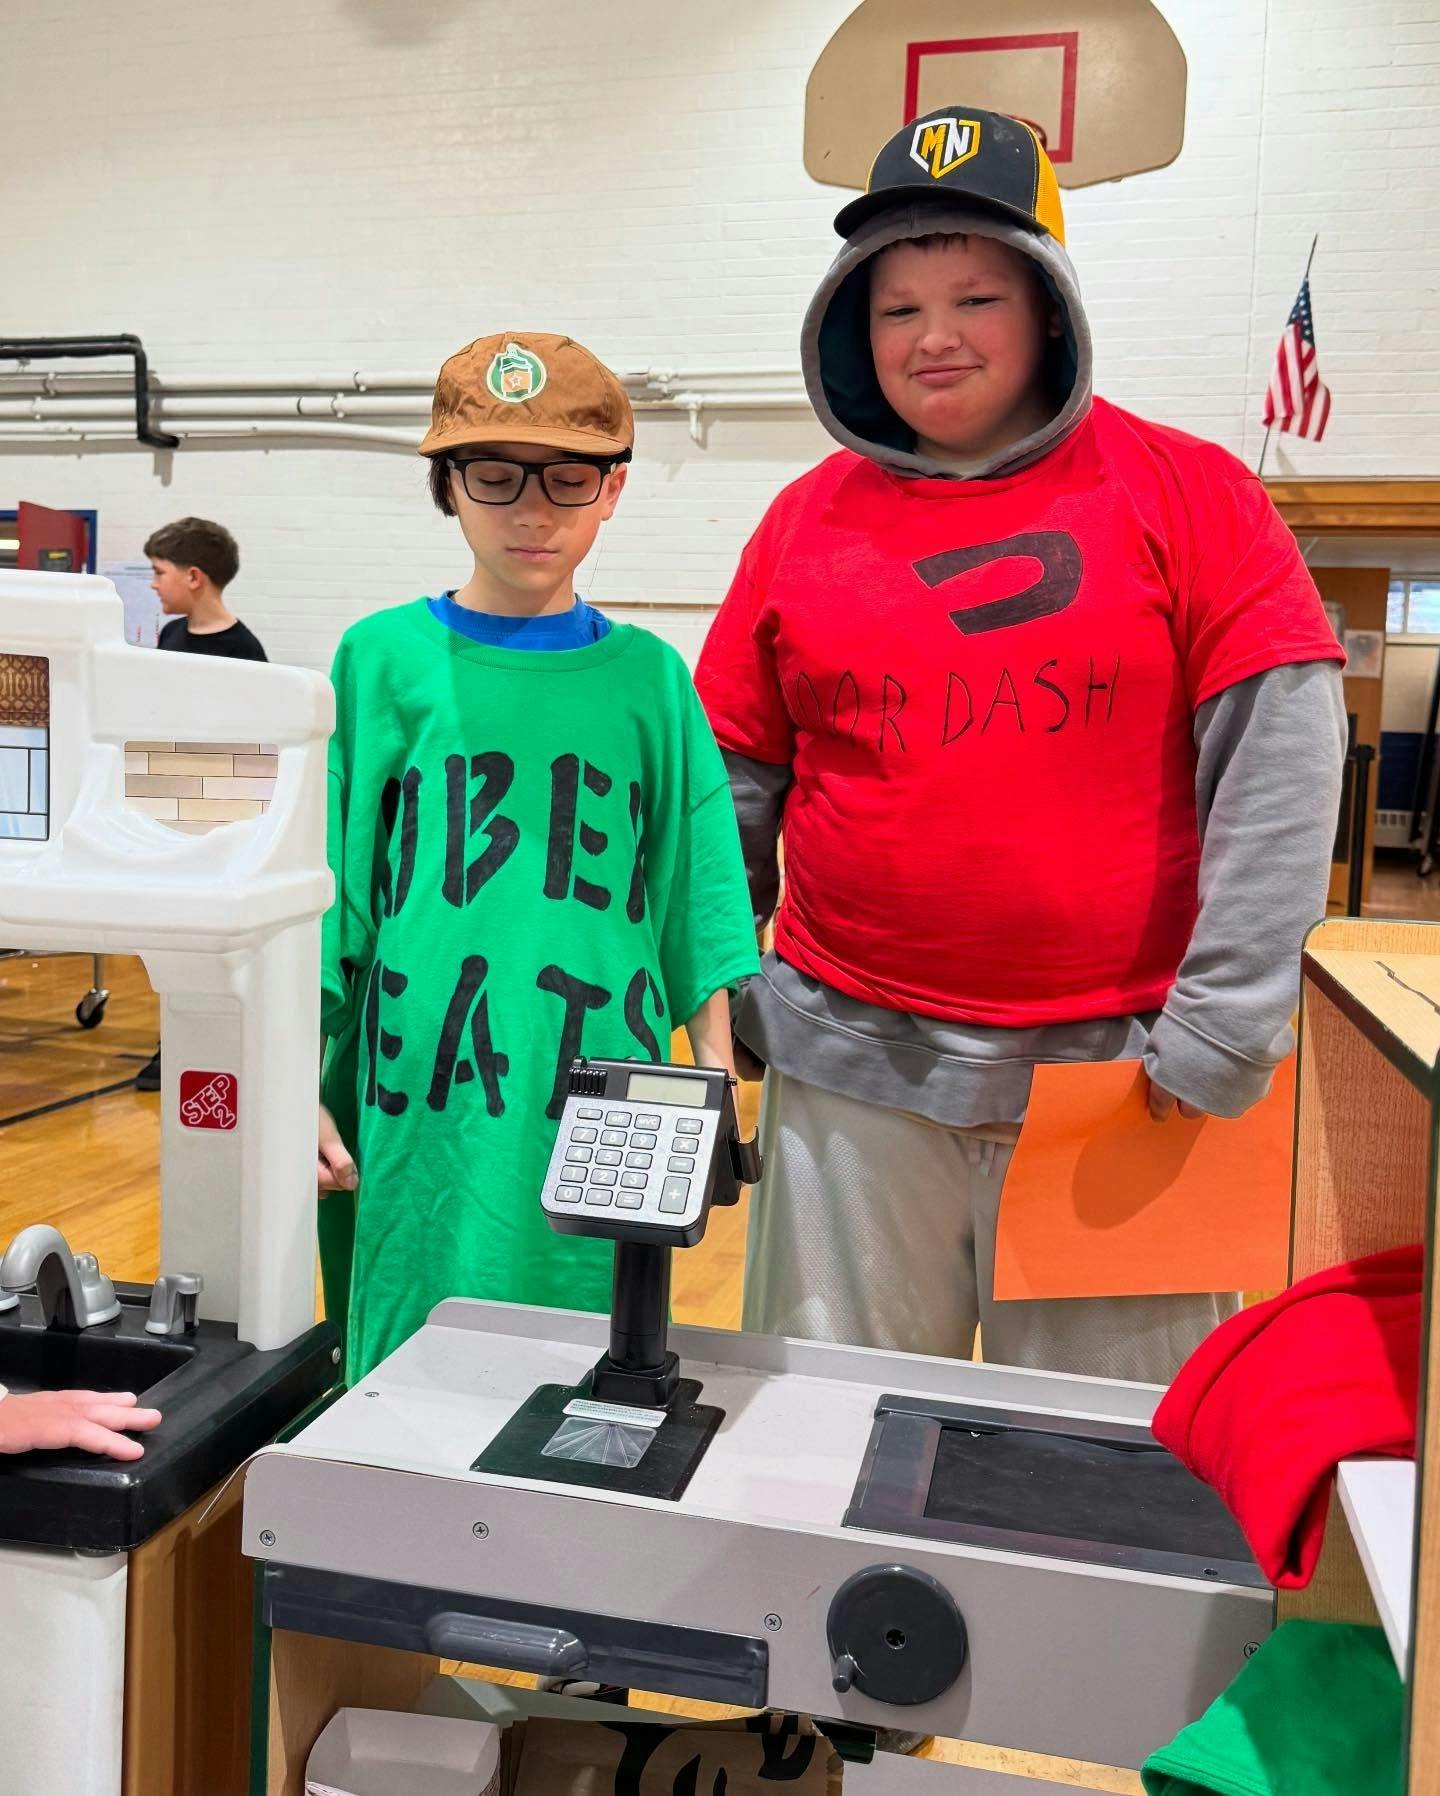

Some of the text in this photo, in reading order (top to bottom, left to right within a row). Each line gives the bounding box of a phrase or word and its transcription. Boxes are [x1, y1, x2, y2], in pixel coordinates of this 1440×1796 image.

[940, 655, 1121, 747] DASH
[181, 1074, 236, 1128] STEP 2
